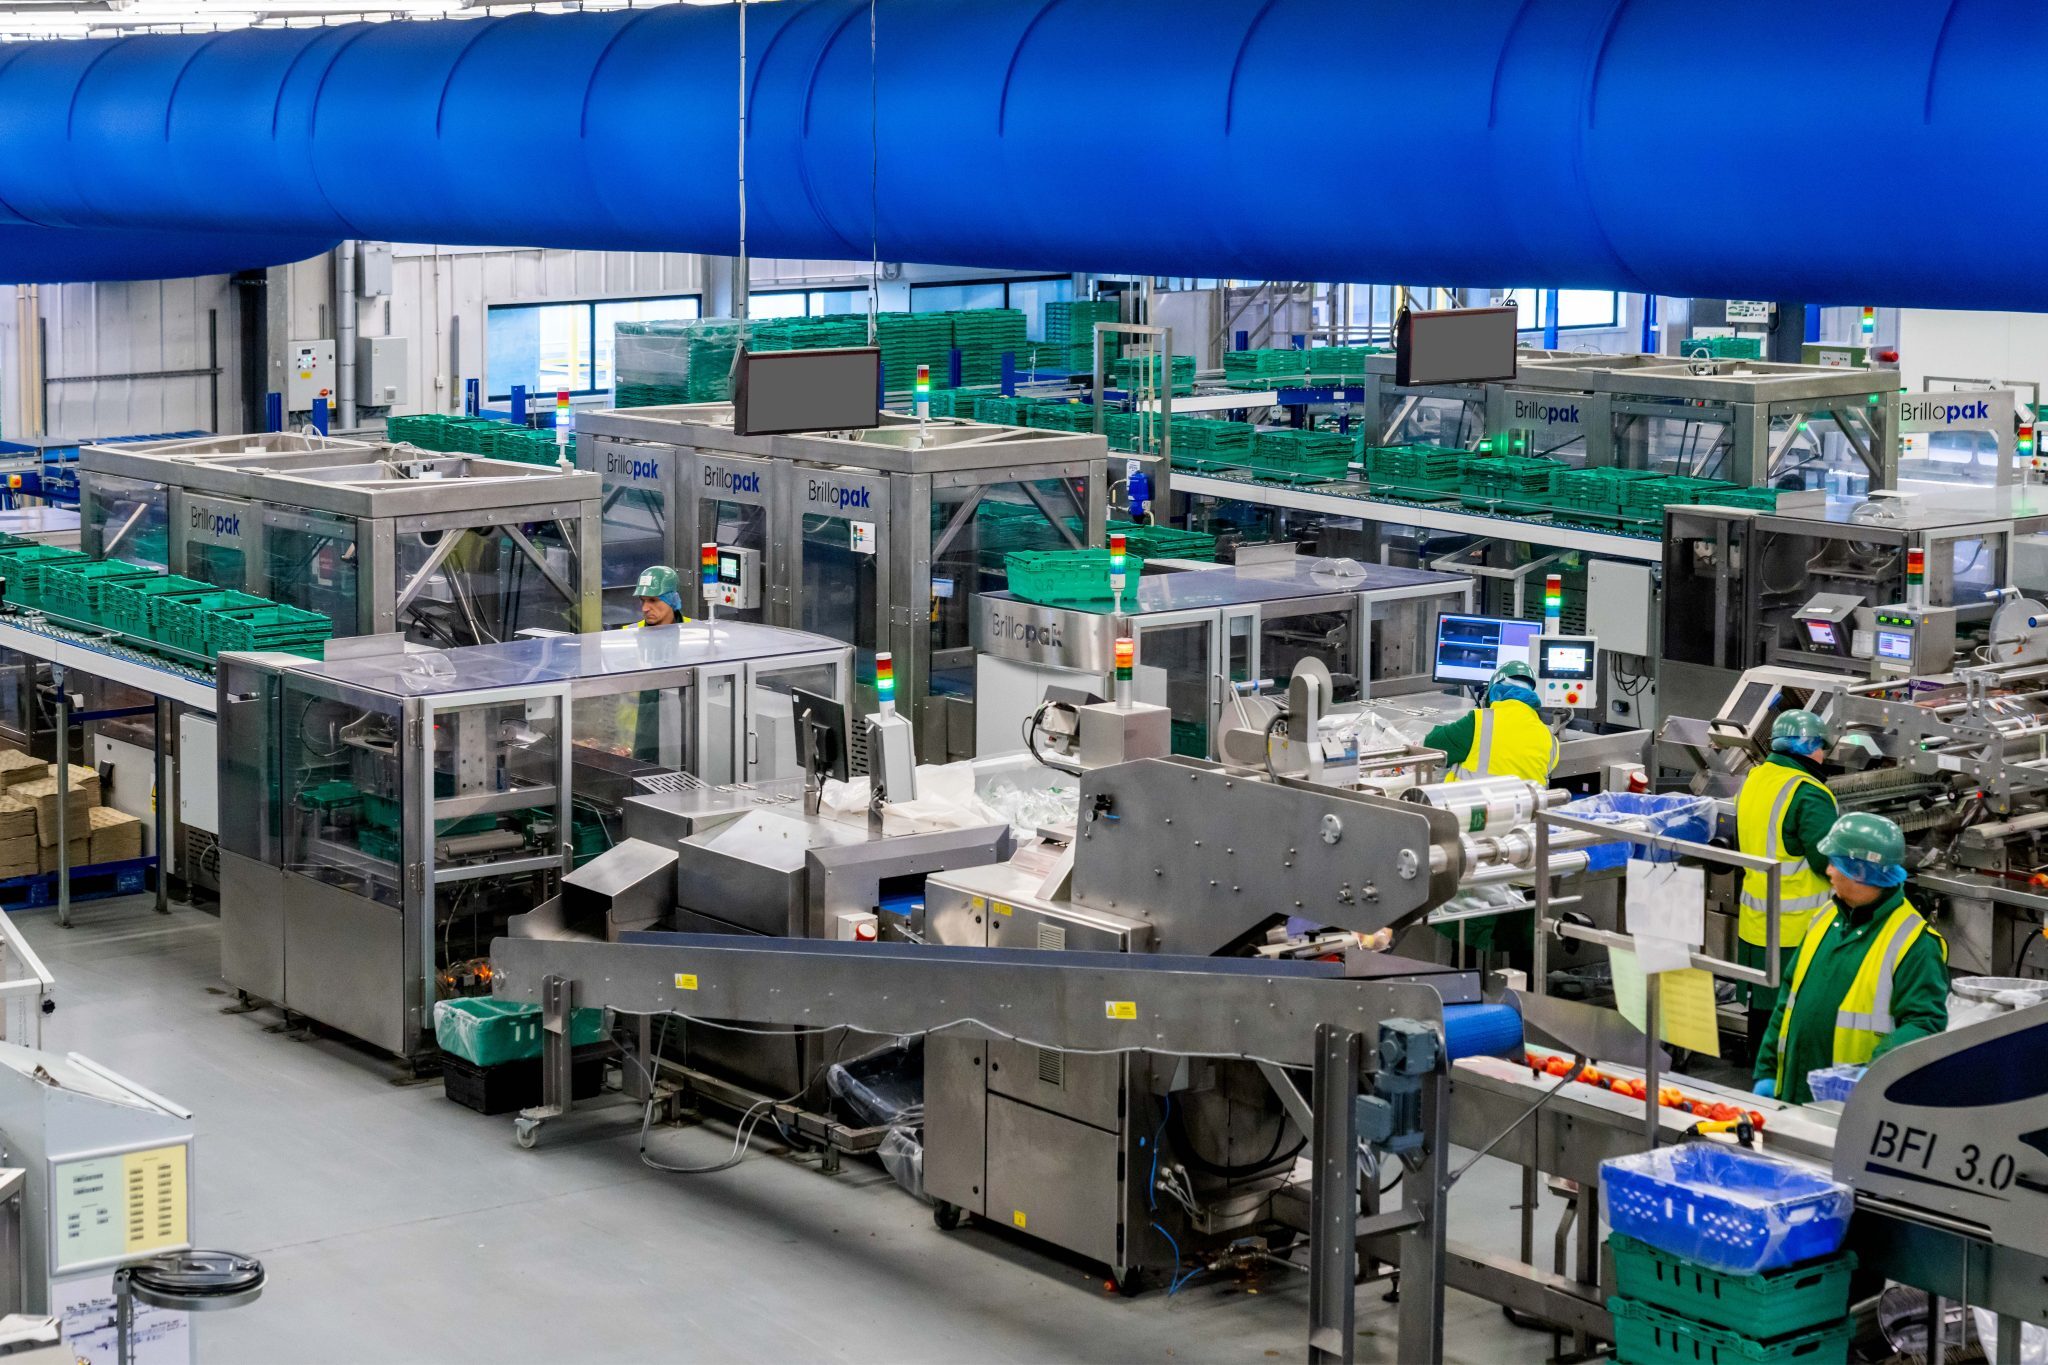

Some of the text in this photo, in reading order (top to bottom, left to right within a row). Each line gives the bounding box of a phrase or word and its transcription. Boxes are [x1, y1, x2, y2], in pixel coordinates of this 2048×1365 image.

[1515, 400, 1579, 425] Brillopak
[1901, 400, 1989, 424] Brillopak
[607, 452, 659, 480] Brillopak
[704, 466, 760, 494] Brillopak
[808, 479, 870, 510] Brillopak
[191, 506, 240, 538] Brillopak
[992, 613, 1063, 648] Brillopak
[1869, 1120, 2015, 1190] BFI 3.0
